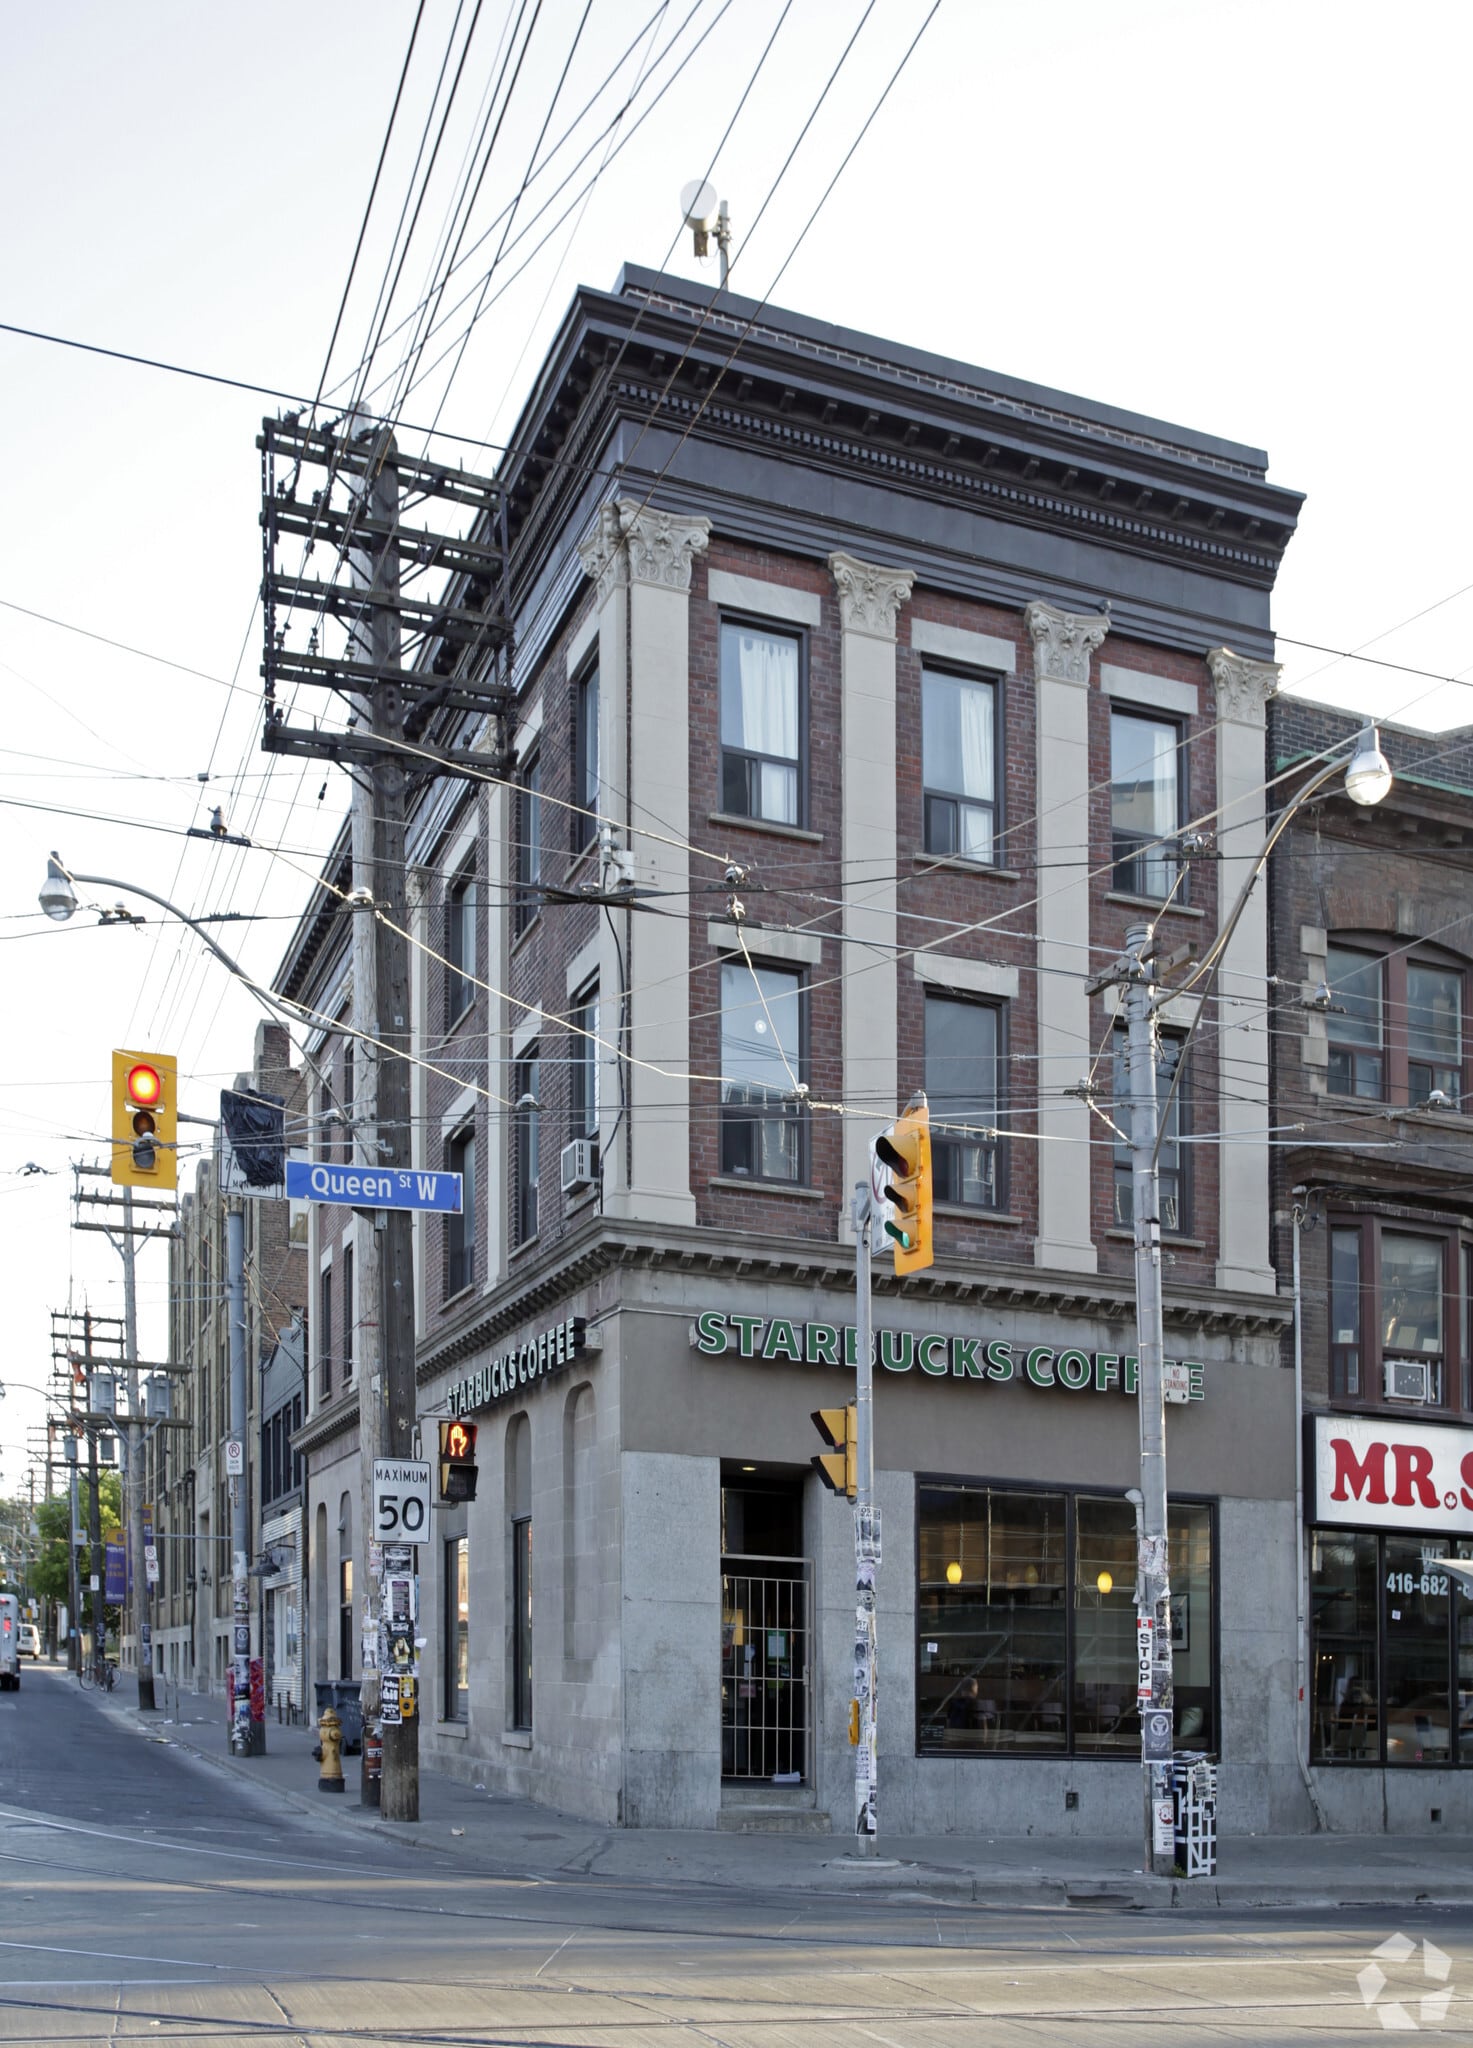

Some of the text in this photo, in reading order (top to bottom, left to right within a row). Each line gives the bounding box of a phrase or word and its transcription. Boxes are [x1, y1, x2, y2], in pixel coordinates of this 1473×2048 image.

[310, 1167, 438, 1201] Queen St W
[446, 1316, 575, 1417] STARBUCKS COFFEE
[1025, 1345, 1205, 1400] COFFE
[1172, 1367, 1180, 1379] NO
[1163, 1378, 1188, 1392] STANDING
[375, 1468, 428, 1484] MAXIMUM
[378, 1494, 425, 1532] 50
[1139, 1633, 1151, 1684] STOP
